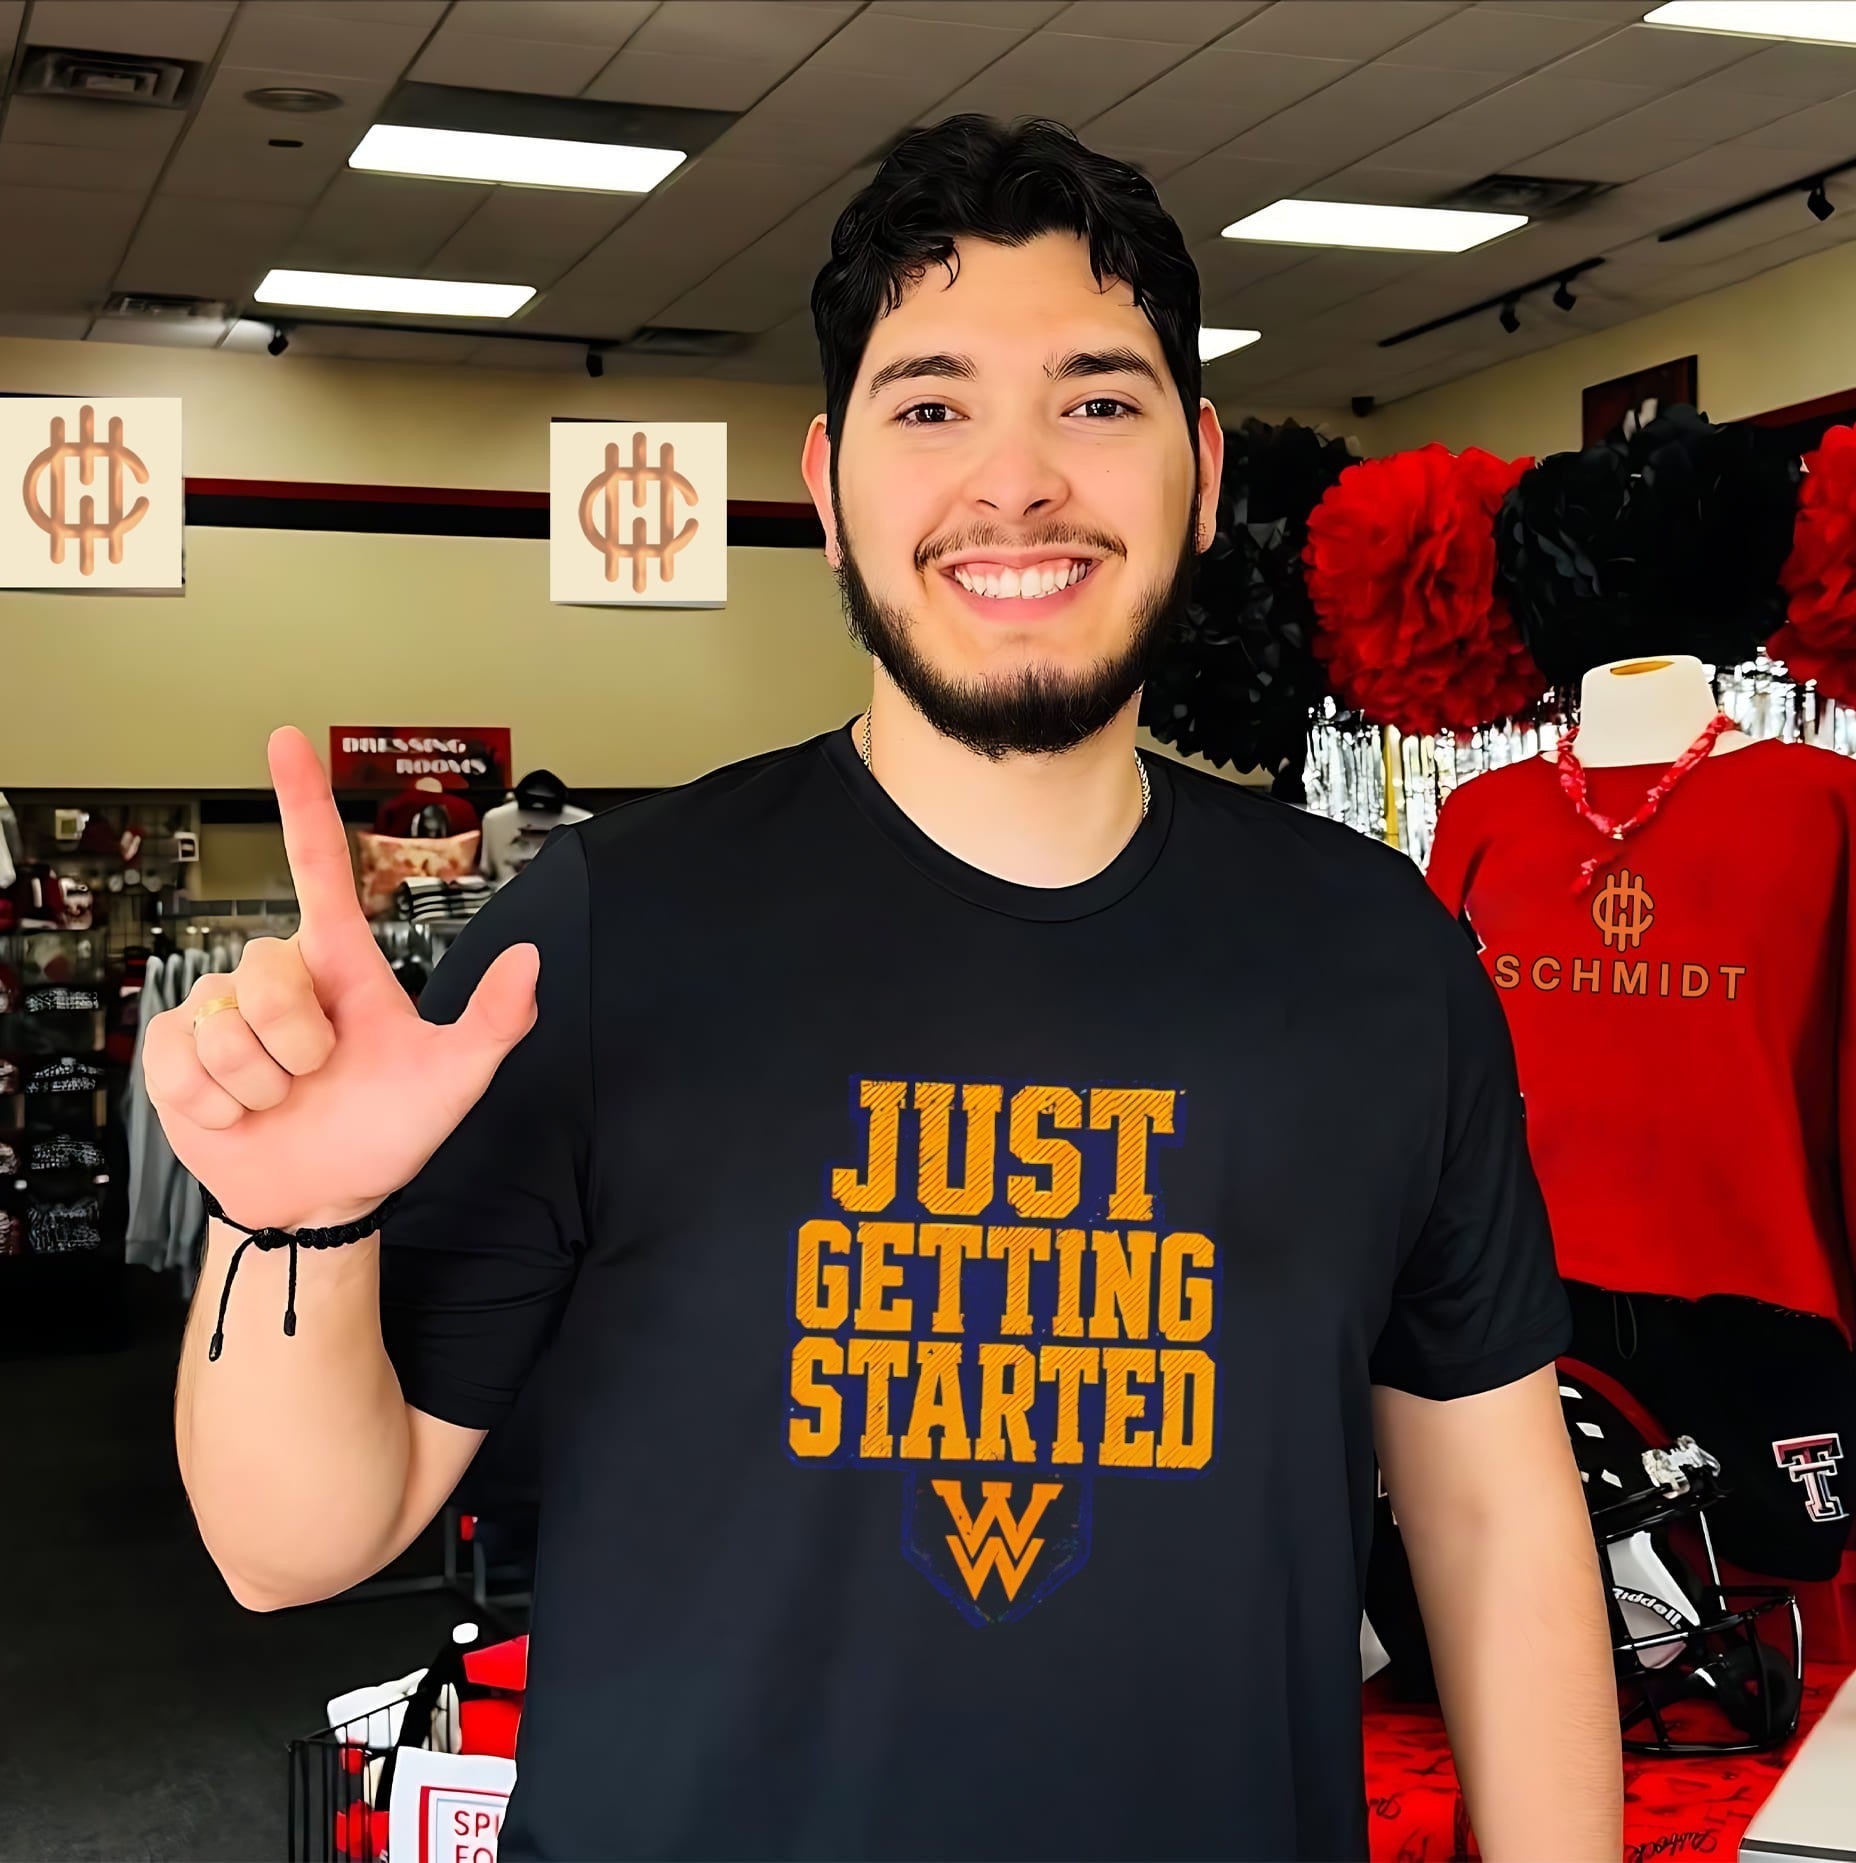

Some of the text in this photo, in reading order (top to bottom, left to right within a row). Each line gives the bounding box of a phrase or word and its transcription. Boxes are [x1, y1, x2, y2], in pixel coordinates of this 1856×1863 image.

[342, 737, 467, 754] DRESSING
[396, 758, 488, 775] ROOMS
[1494, 954, 1747, 1001] SCHMIDT
[831, 1080, 1177, 1222] JUST
[794, 1218, 1217, 1343] GETTING
[788, 1335, 1217, 1470] STARTED
